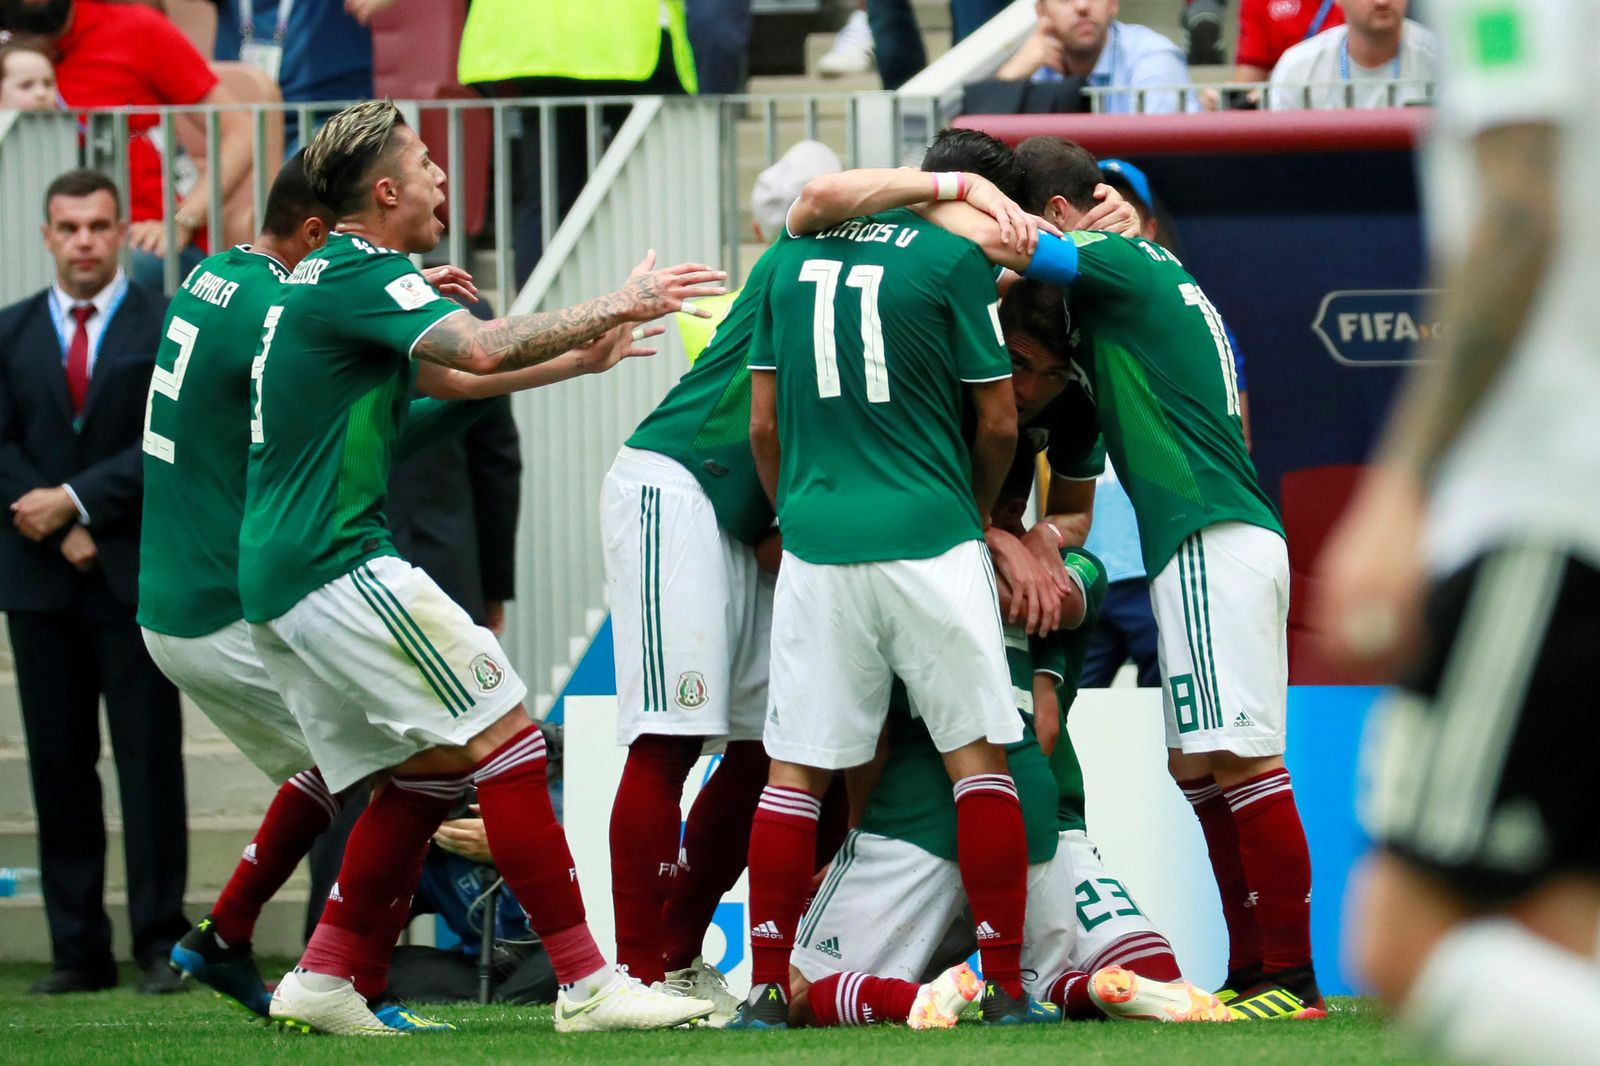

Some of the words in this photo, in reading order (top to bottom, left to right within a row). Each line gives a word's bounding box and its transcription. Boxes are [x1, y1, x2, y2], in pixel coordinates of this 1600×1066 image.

[189, 270, 240, 308] AYALA
[798, 258, 890, 403] 11
[142, 315, 199, 464] 2
[1169, 673, 1200, 734] 8
[1074, 878, 1143, 933] 23
[815, 943, 843, 960] adidas
